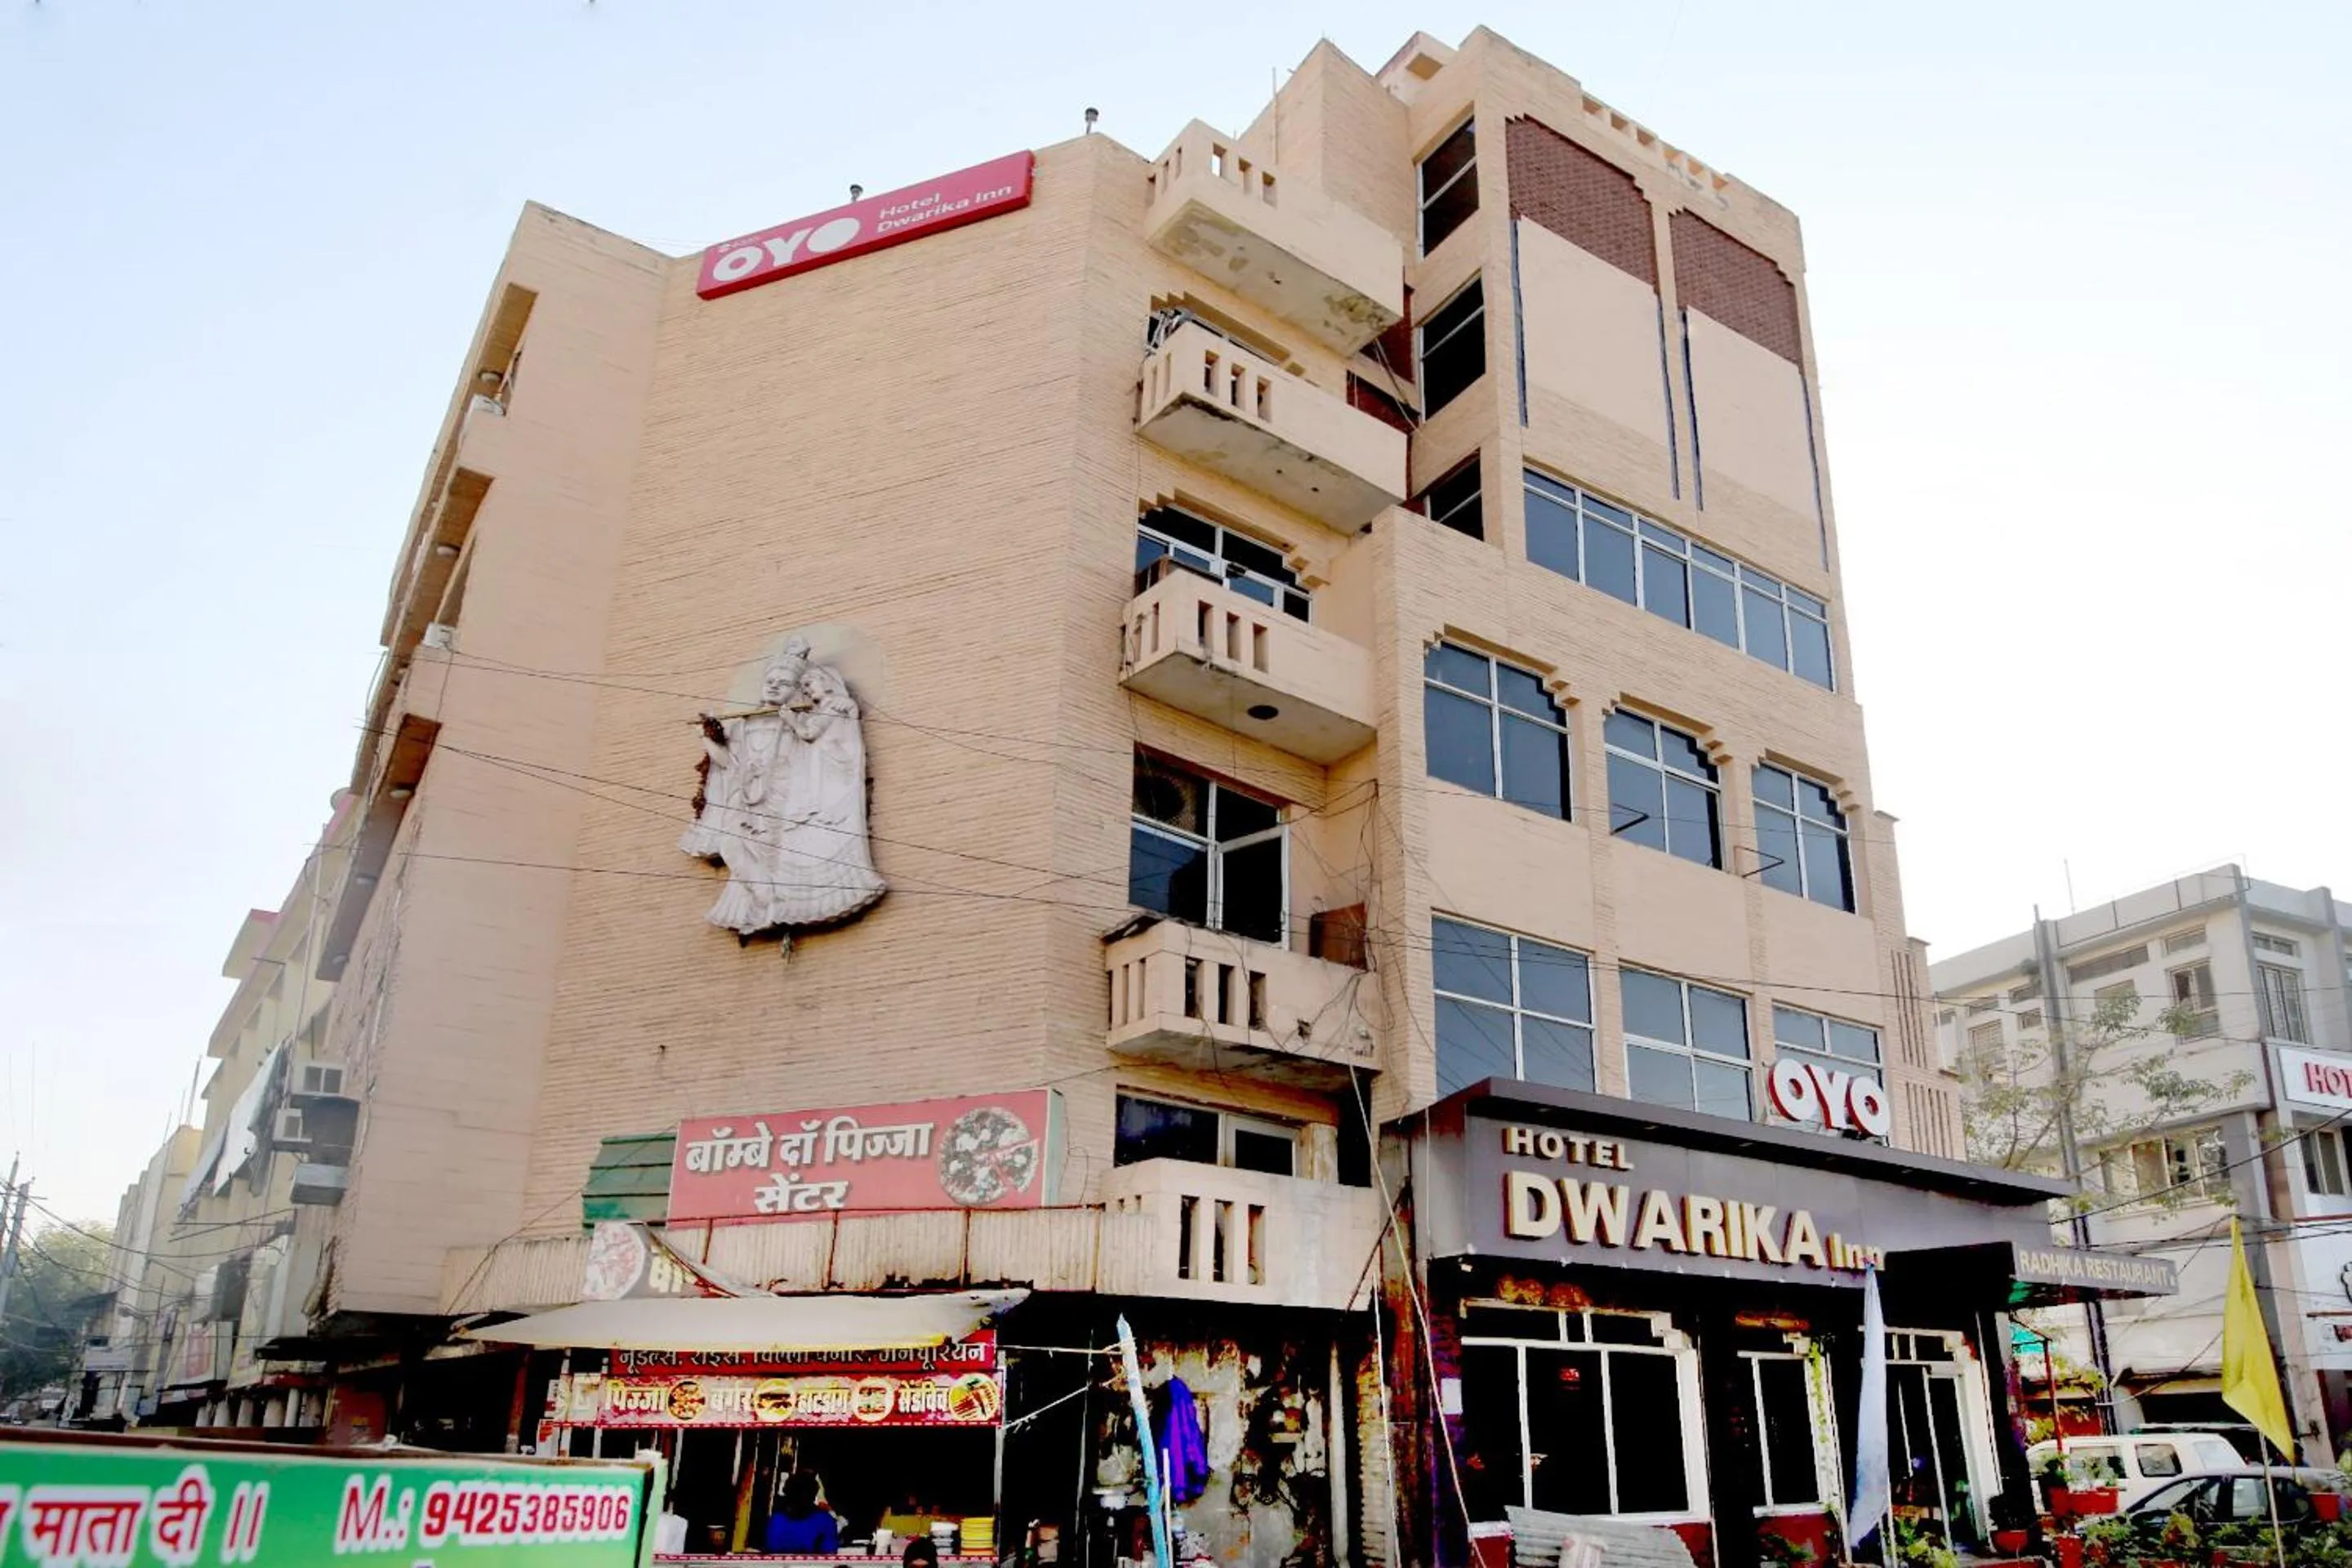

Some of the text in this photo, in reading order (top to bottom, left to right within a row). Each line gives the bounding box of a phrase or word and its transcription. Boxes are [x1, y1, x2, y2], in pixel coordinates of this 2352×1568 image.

[877, 185, 1013, 233] Dwarika Inn
[879, 193, 941, 219] Hotel
[713, 217, 861, 282] OYO
[1767, 1058, 1890, 1138] OYO
[686, 1120, 773, 1173] बॉम्बे
[824, 1116, 934, 1164] पिज्जा
[1503, 1126, 1633, 1171] HOTEL
[754, 1173, 849, 1214] सेंटर
[1505, 1170, 1885, 1271] DWARIKA Inn
[2019, 1250, 2083, 1279] RADHIKA
[30, 1500, 142, 1557] माता
[157, 1478, 207, 1552] दी
[422, 1490, 631, 1537] 9425385906
